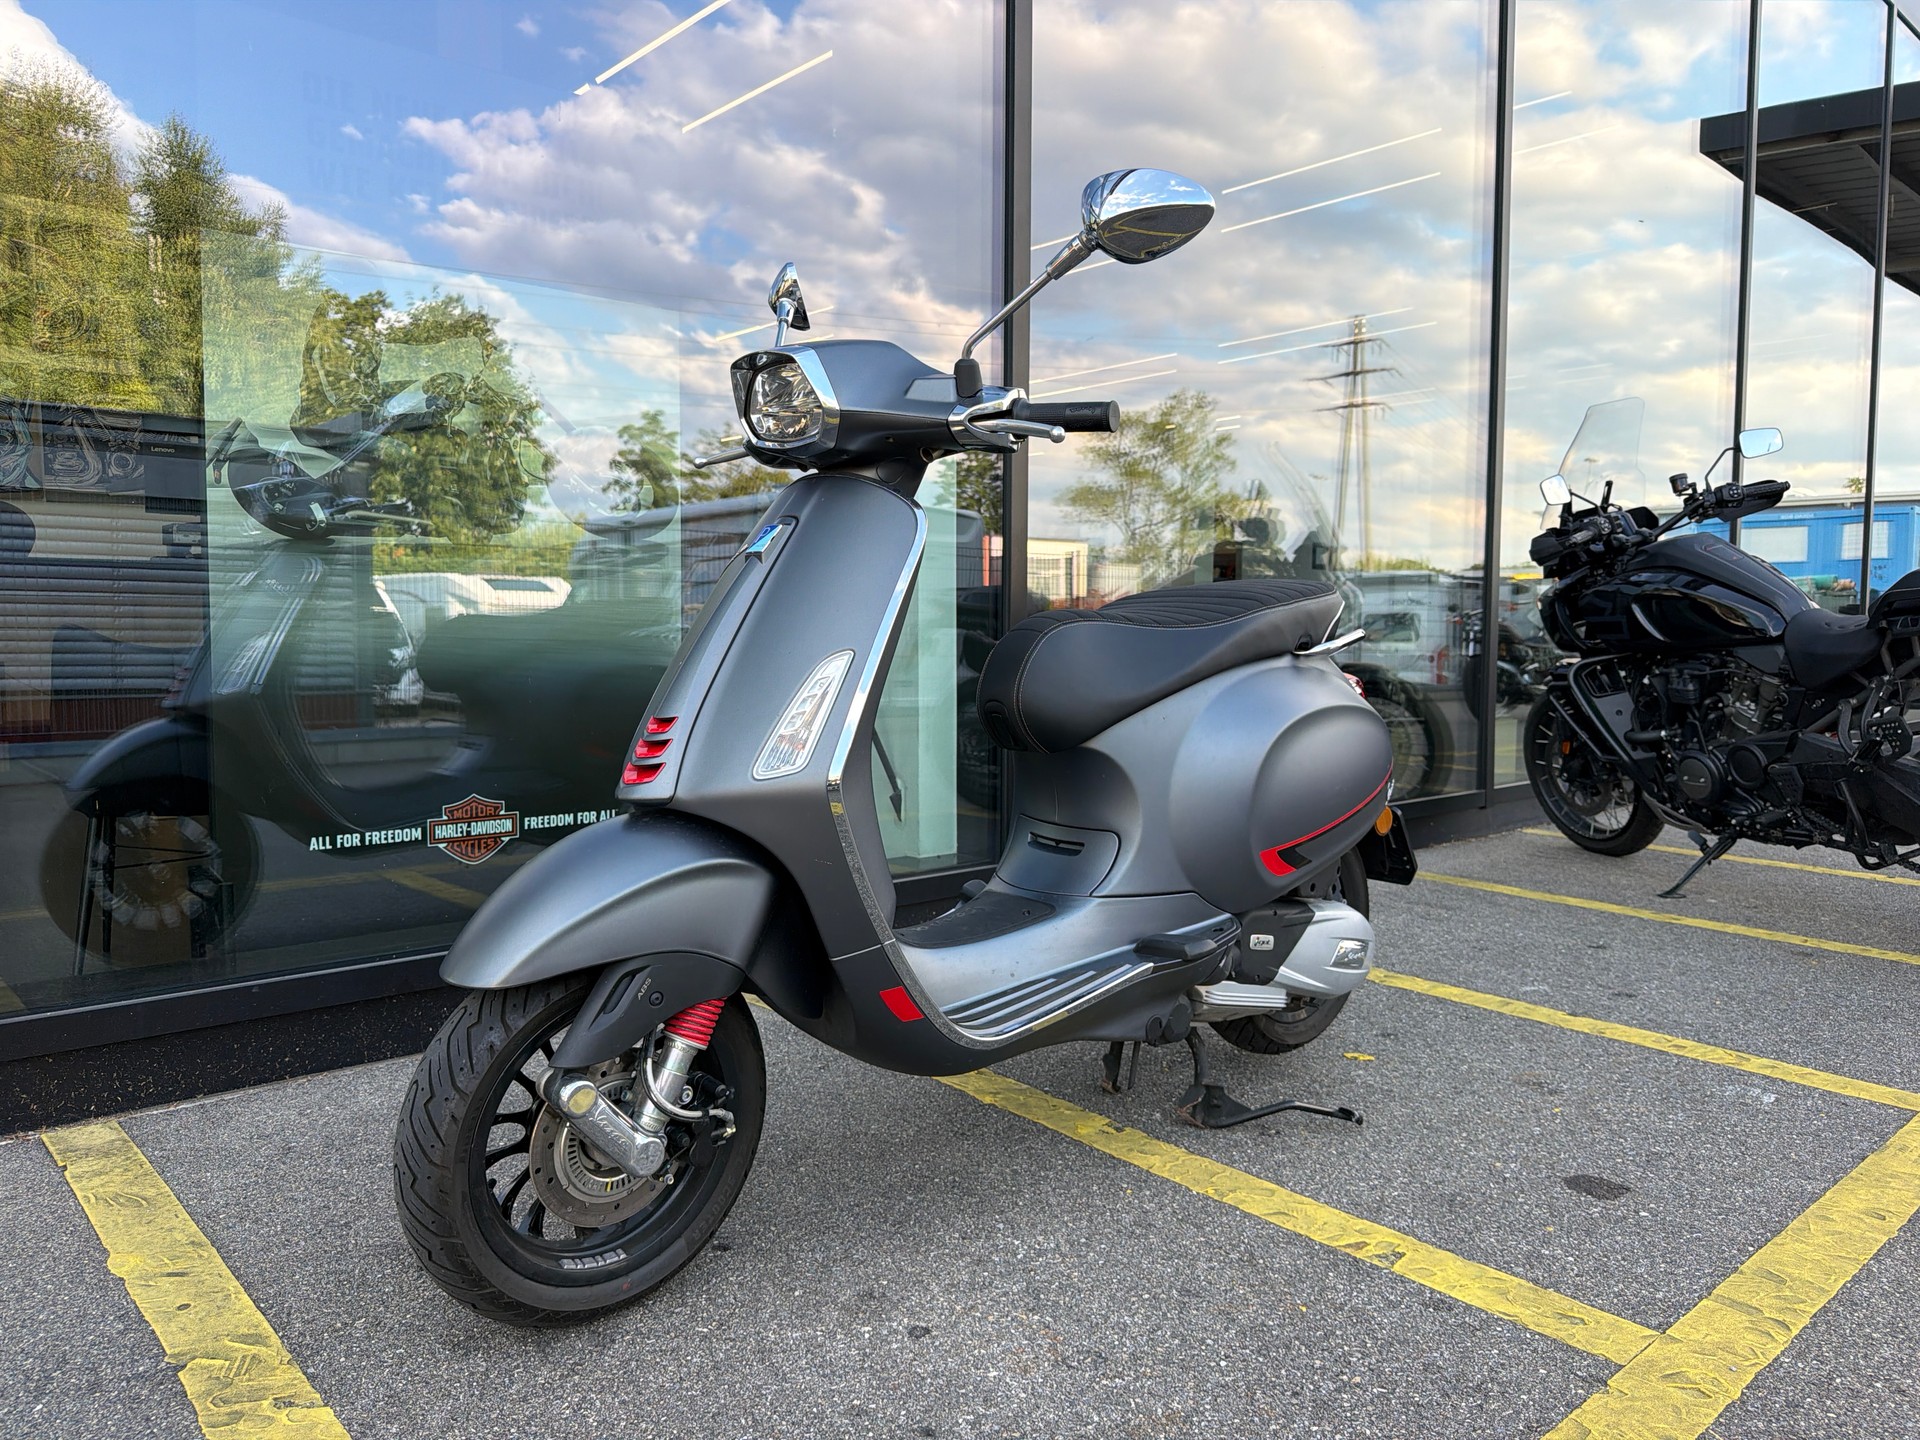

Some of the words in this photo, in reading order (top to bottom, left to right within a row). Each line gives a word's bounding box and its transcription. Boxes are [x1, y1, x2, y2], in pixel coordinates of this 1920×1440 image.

[453, 803, 495, 819] MOTOR
[524, 813, 573, 830] FREEDOM
[577, 811, 598, 824] FOR
[309, 836, 332, 851] ALL
[336, 833, 361, 849] FOR
[365, 827, 422, 847] FREEDOM
[434, 818, 513, 840] HARLEY-DAVIDSON
[452, 838, 495, 858] CYCLES
[637, 977, 652, 1001] ABS
